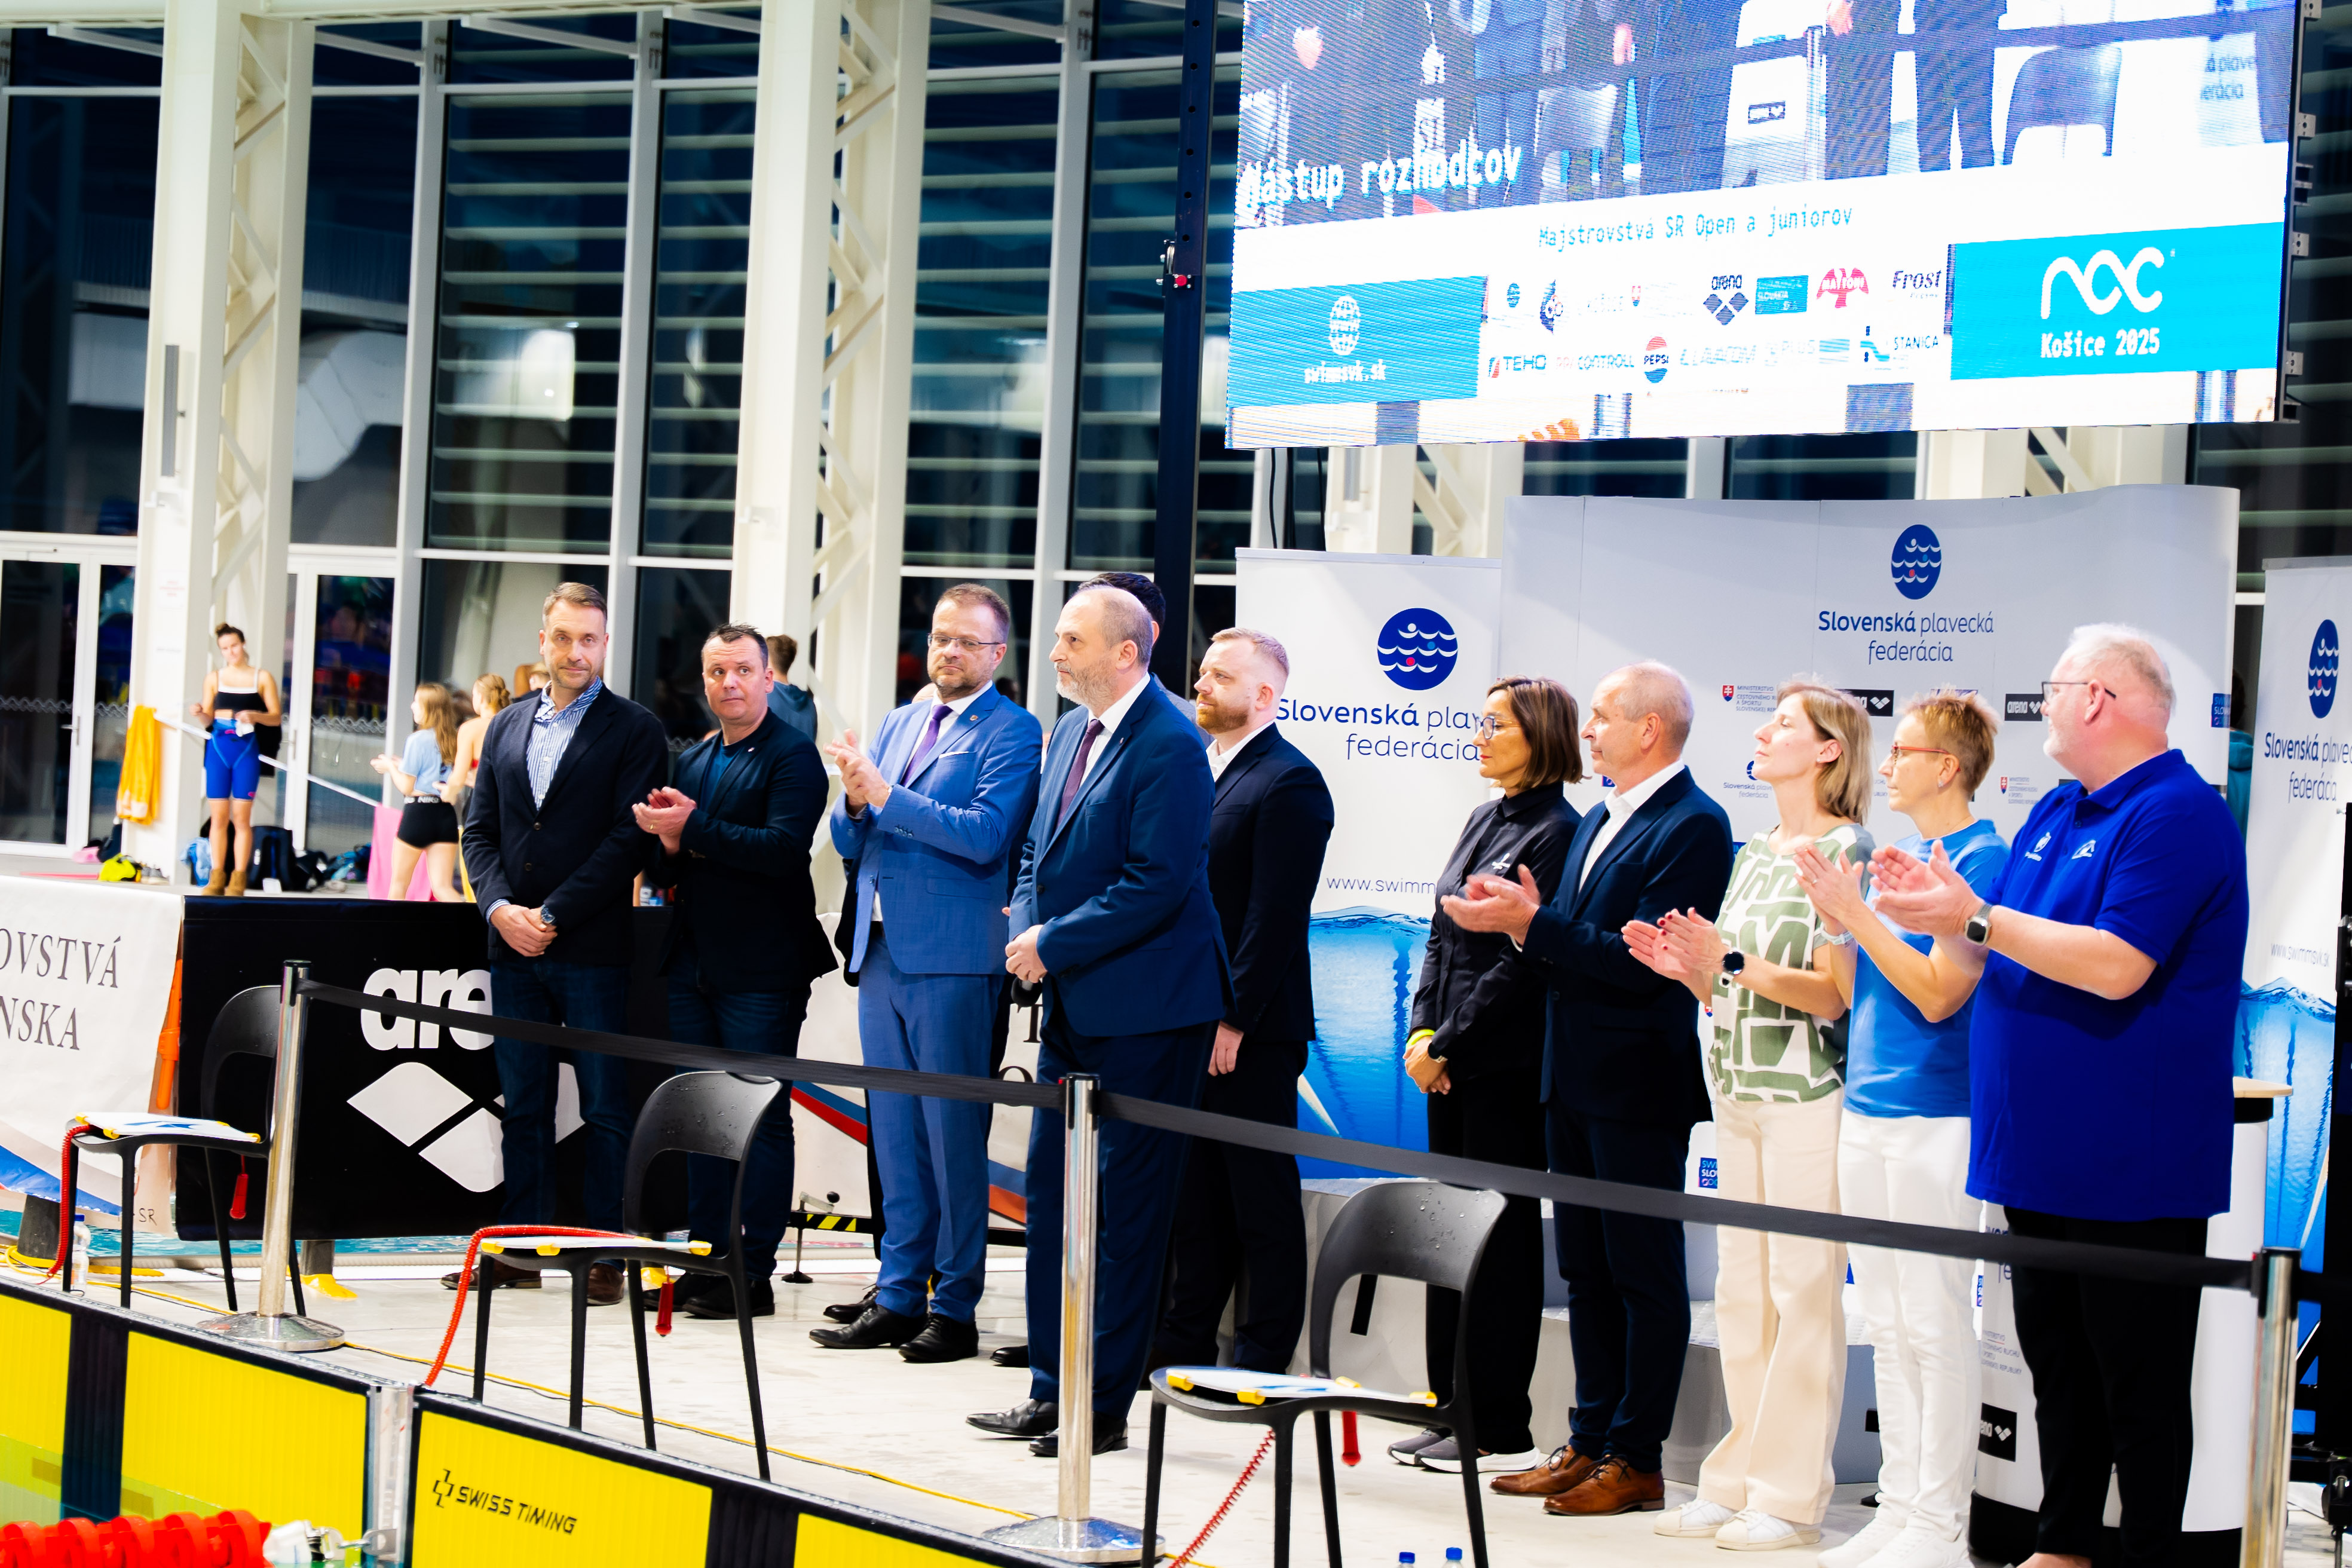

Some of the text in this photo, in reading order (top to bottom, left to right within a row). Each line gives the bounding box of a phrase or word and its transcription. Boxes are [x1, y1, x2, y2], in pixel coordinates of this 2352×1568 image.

[1539, 202, 1852, 252] Majstrovstvá SR Open a juniorov
[1892, 270, 1942, 289] Frost
[1894, 335, 1938, 350] STANICA
[2041, 327, 2160, 358] Košice 2025
[1503, 354, 1546, 371] TEHO
[1818, 611, 1993, 637] Slovenská plavecká
[1868, 641, 1953, 664] federácia
[1276, 698, 1419, 726] Slovenská
[2007, 701, 2028, 713] arena
[1346, 733, 1480, 761] federácia
[2264, 732, 2319, 761] Slovenská
[456, 1486, 577, 1535] SWISS TIMING
